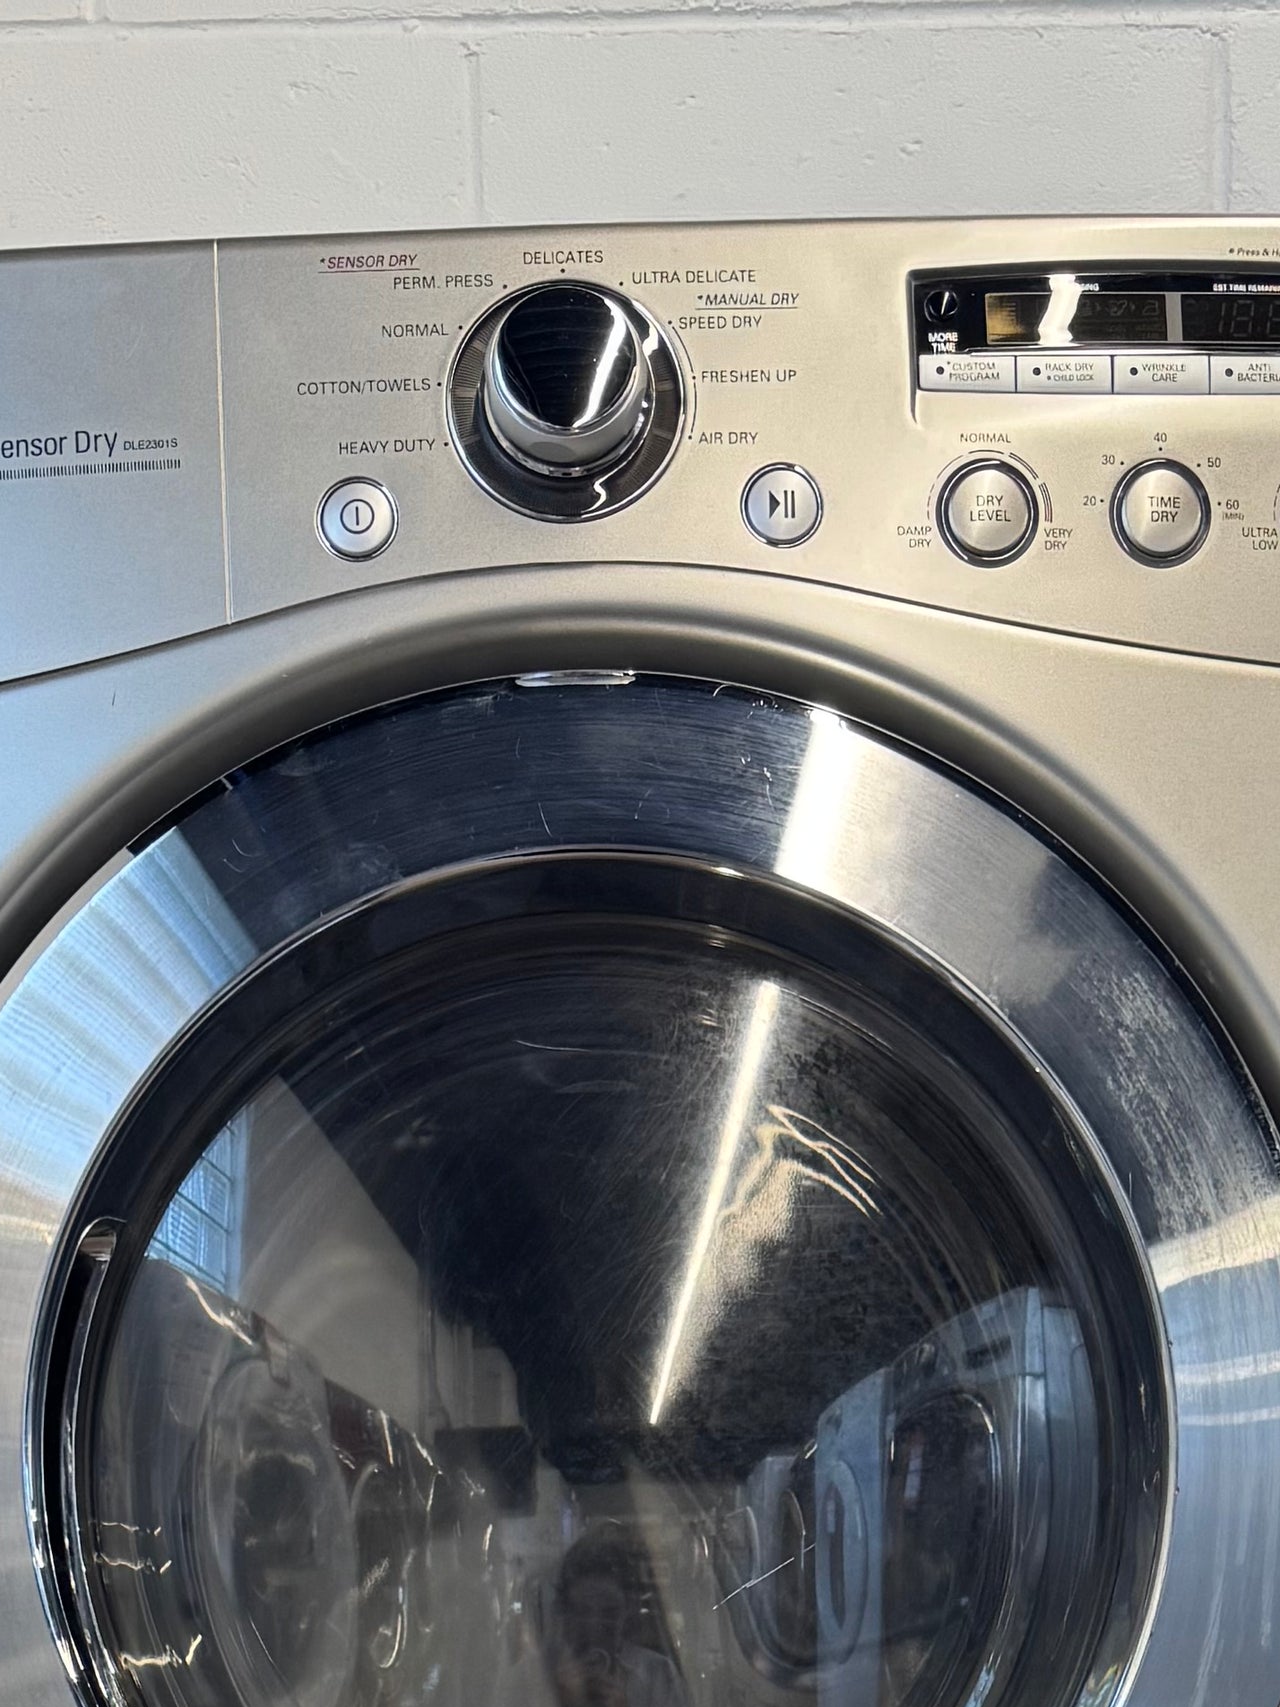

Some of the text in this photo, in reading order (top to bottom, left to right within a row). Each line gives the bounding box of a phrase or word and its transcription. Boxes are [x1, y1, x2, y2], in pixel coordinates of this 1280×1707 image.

[383, 255, 417, 267] DRY
[523, 251, 603, 265] DELICATES
[394, 275, 493, 289] PERM. PRESS
[632, 270, 755, 284] ULTRA DELICATE
[769, 293, 799, 305] DRY
[679, 317, 762, 329] SPEED DRY
[382, 325, 448, 338] NORMAL
[702, 370, 796, 383] FRESHEN UP
[297, 378, 431, 396] COTTON/TOWELS
[74, 431, 117, 457] Dry
[699, 432, 758, 445] AIR DRY
[960, 433, 1011, 444] NORMAL
[339, 439, 435, 454] HEAVY DUTY
[1102, 433, 1221, 468] 30 40 50
[977, 496, 1003, 508] DRY
[1083, 496, 1096, 507] 20
[1148, 497, 1180, 509] TIME
[1226, 499, 1239, 510] 60
[970, 510, 1011, 522] LEVEL
[1151, 510, 1178, 523] DRY
[897, 526, 932, 537] DAMP
[1044, 529, 1072, 539] VERY
[1243, 528, 1278, 539] ULTRA
[910, 538, 931, 549] DRY
[1046, 540, 1066, 551] DRY
[1253, 540, 1278, 550] LOW
